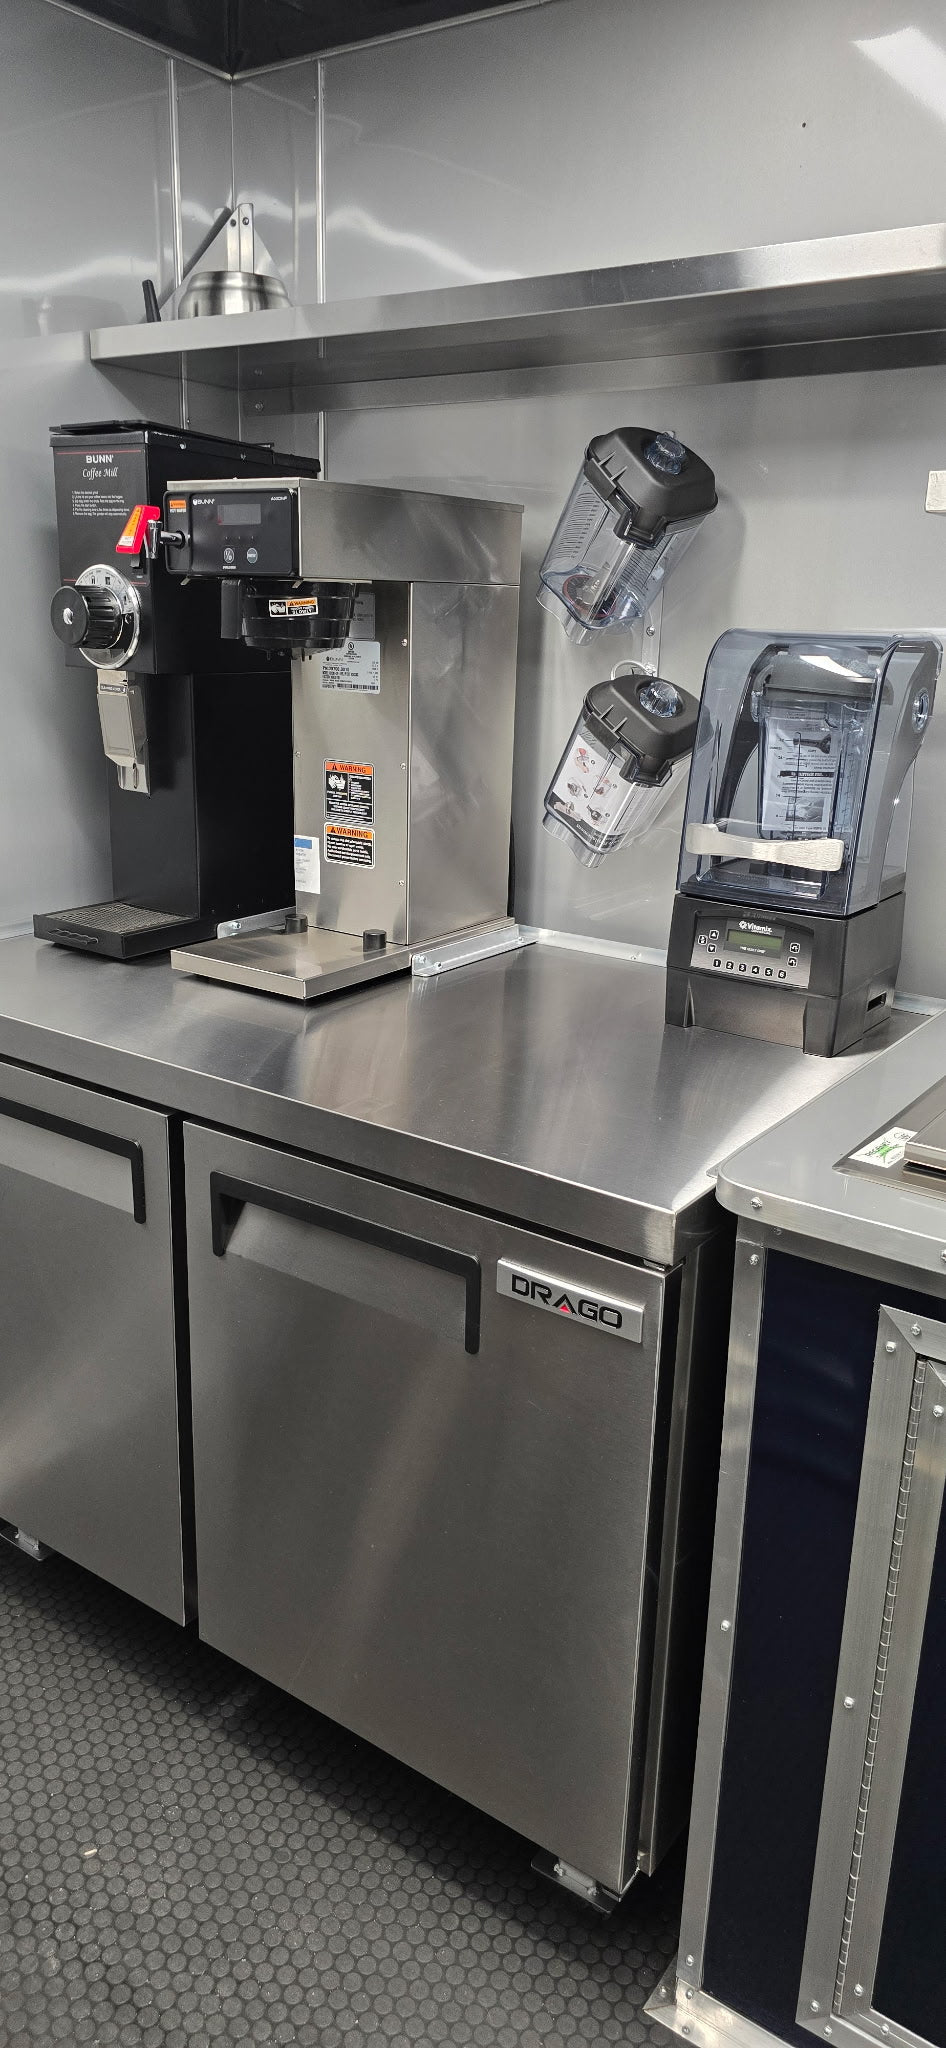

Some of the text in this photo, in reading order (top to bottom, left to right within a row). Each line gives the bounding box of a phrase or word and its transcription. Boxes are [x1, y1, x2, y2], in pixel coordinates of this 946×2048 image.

[82, 466, 119, 481] Coffee Mill
[339, 764, 366, 774] WARNING
[337, 827, 368, 839] WARNING
[747, 922, 772, 932] Vitamix
[511, 1273, 623, 1330] DRAGO
